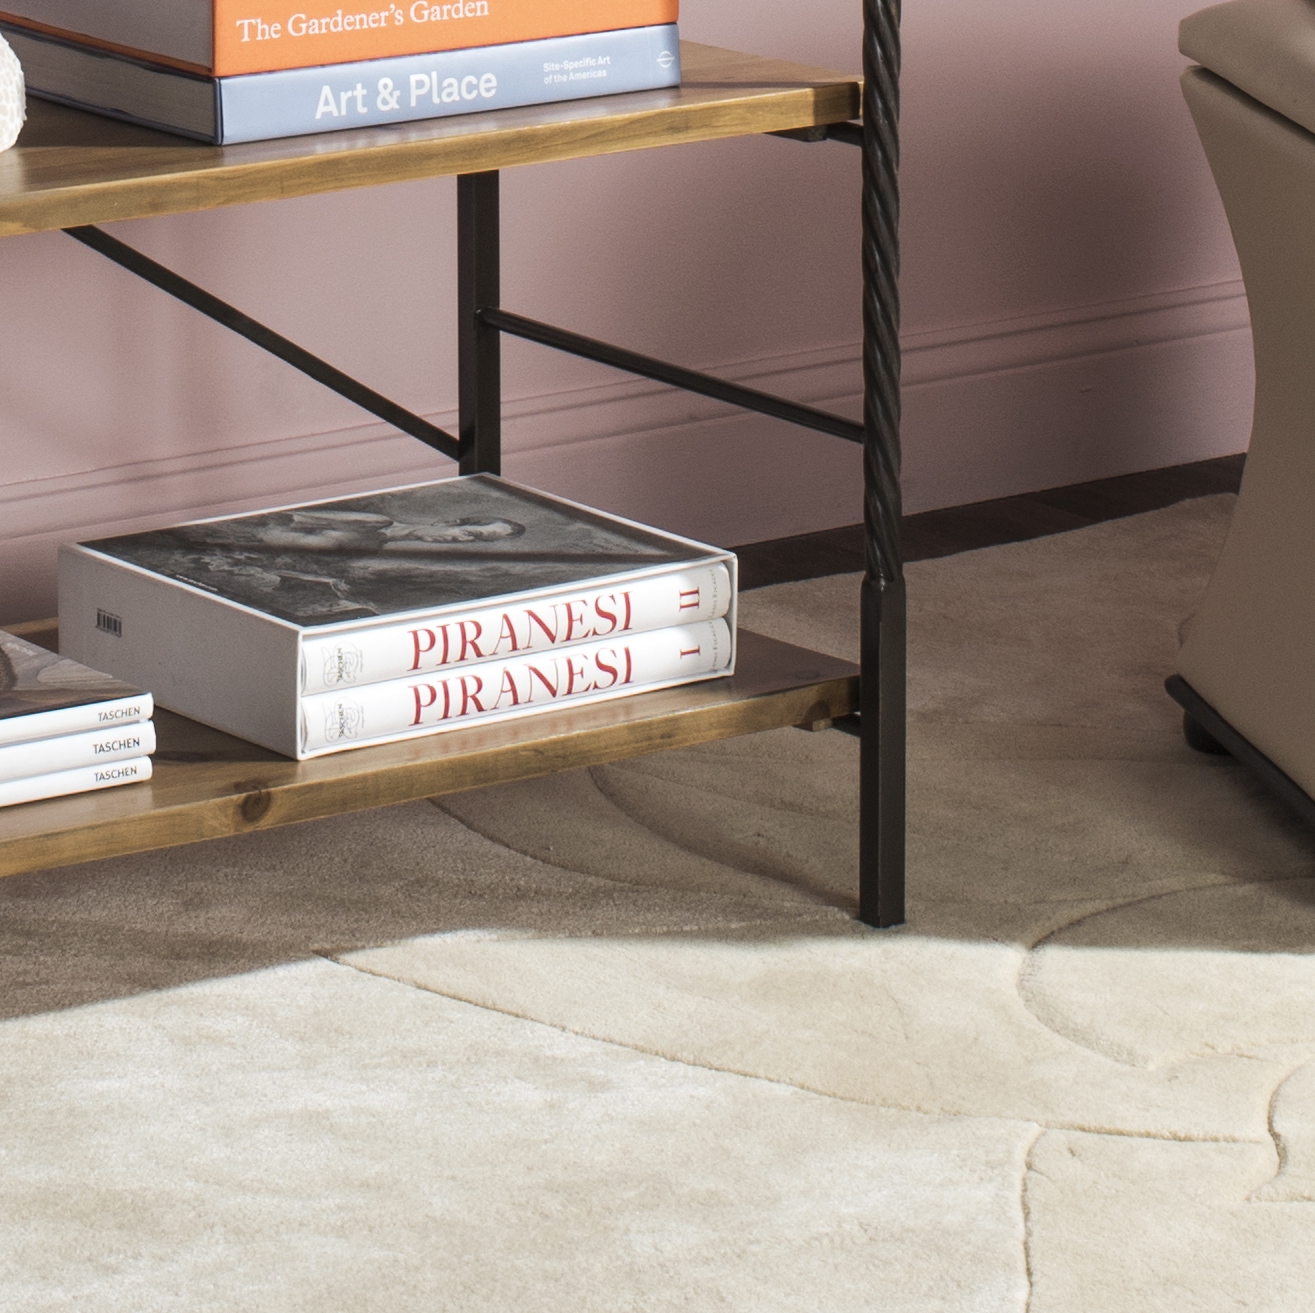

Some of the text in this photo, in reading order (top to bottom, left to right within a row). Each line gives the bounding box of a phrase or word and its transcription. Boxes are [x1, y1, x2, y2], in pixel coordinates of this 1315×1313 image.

[236, 18, 282, 43] The
[287, 3, 405, 37] Gardener's
[543, 55, 611, 72] Site-Specific Art
[544, 69, 607, 84] of the Americas
[314, 71, 498, 120] Art & Place
[407, 591, 633, 672] PIRANESI
[679, 585, 700, 612] II
[408, 646, 634, 726] PIRANESI
[98, 706, 141, 722] TASCHEN
[93, 737, 141, 754] TASCHEN
[94, 766, 138, 782] TASCHEN
